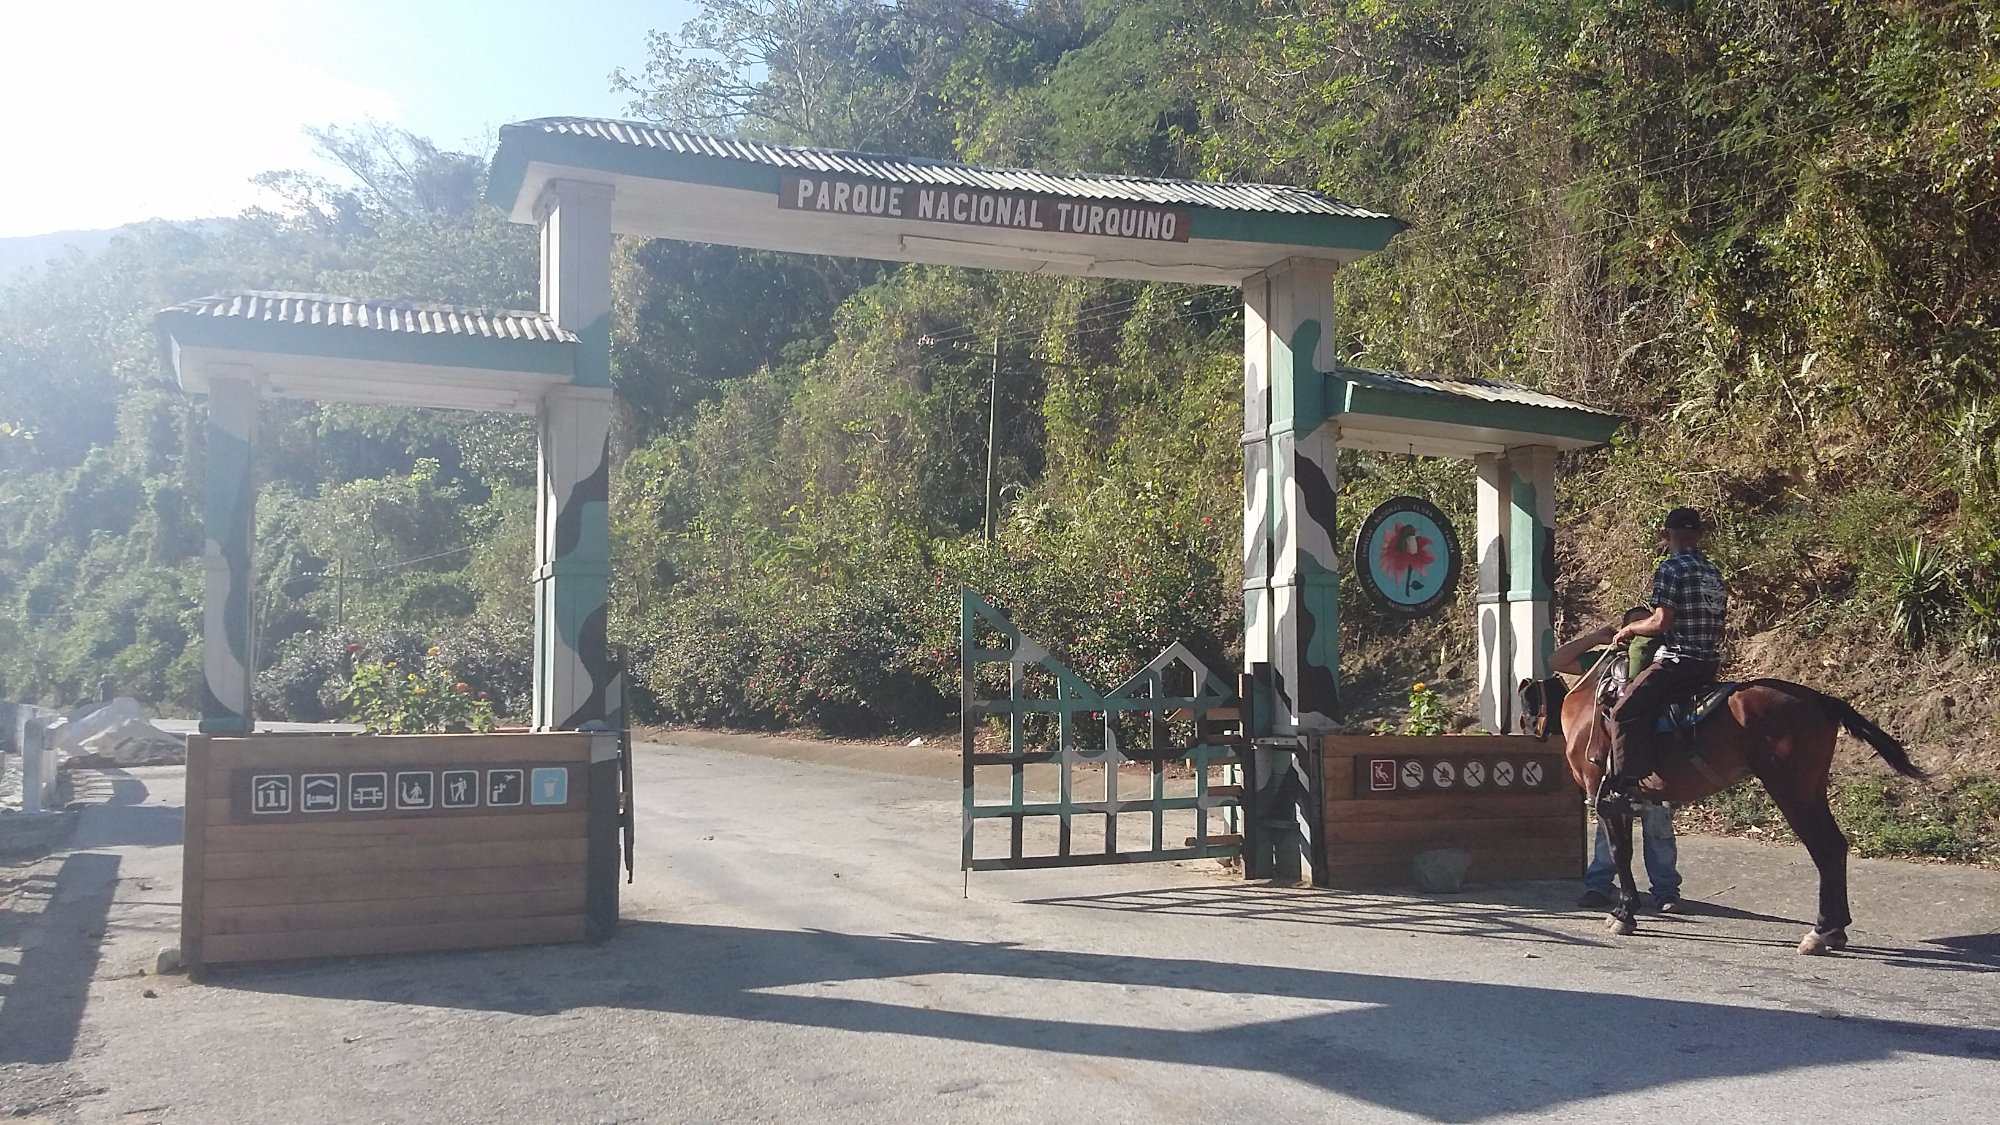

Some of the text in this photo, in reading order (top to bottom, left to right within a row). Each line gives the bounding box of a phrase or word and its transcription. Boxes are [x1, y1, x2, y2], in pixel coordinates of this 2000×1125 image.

[798, 179, 1176, 240] PARQUE NACIONAL TURQUINO
